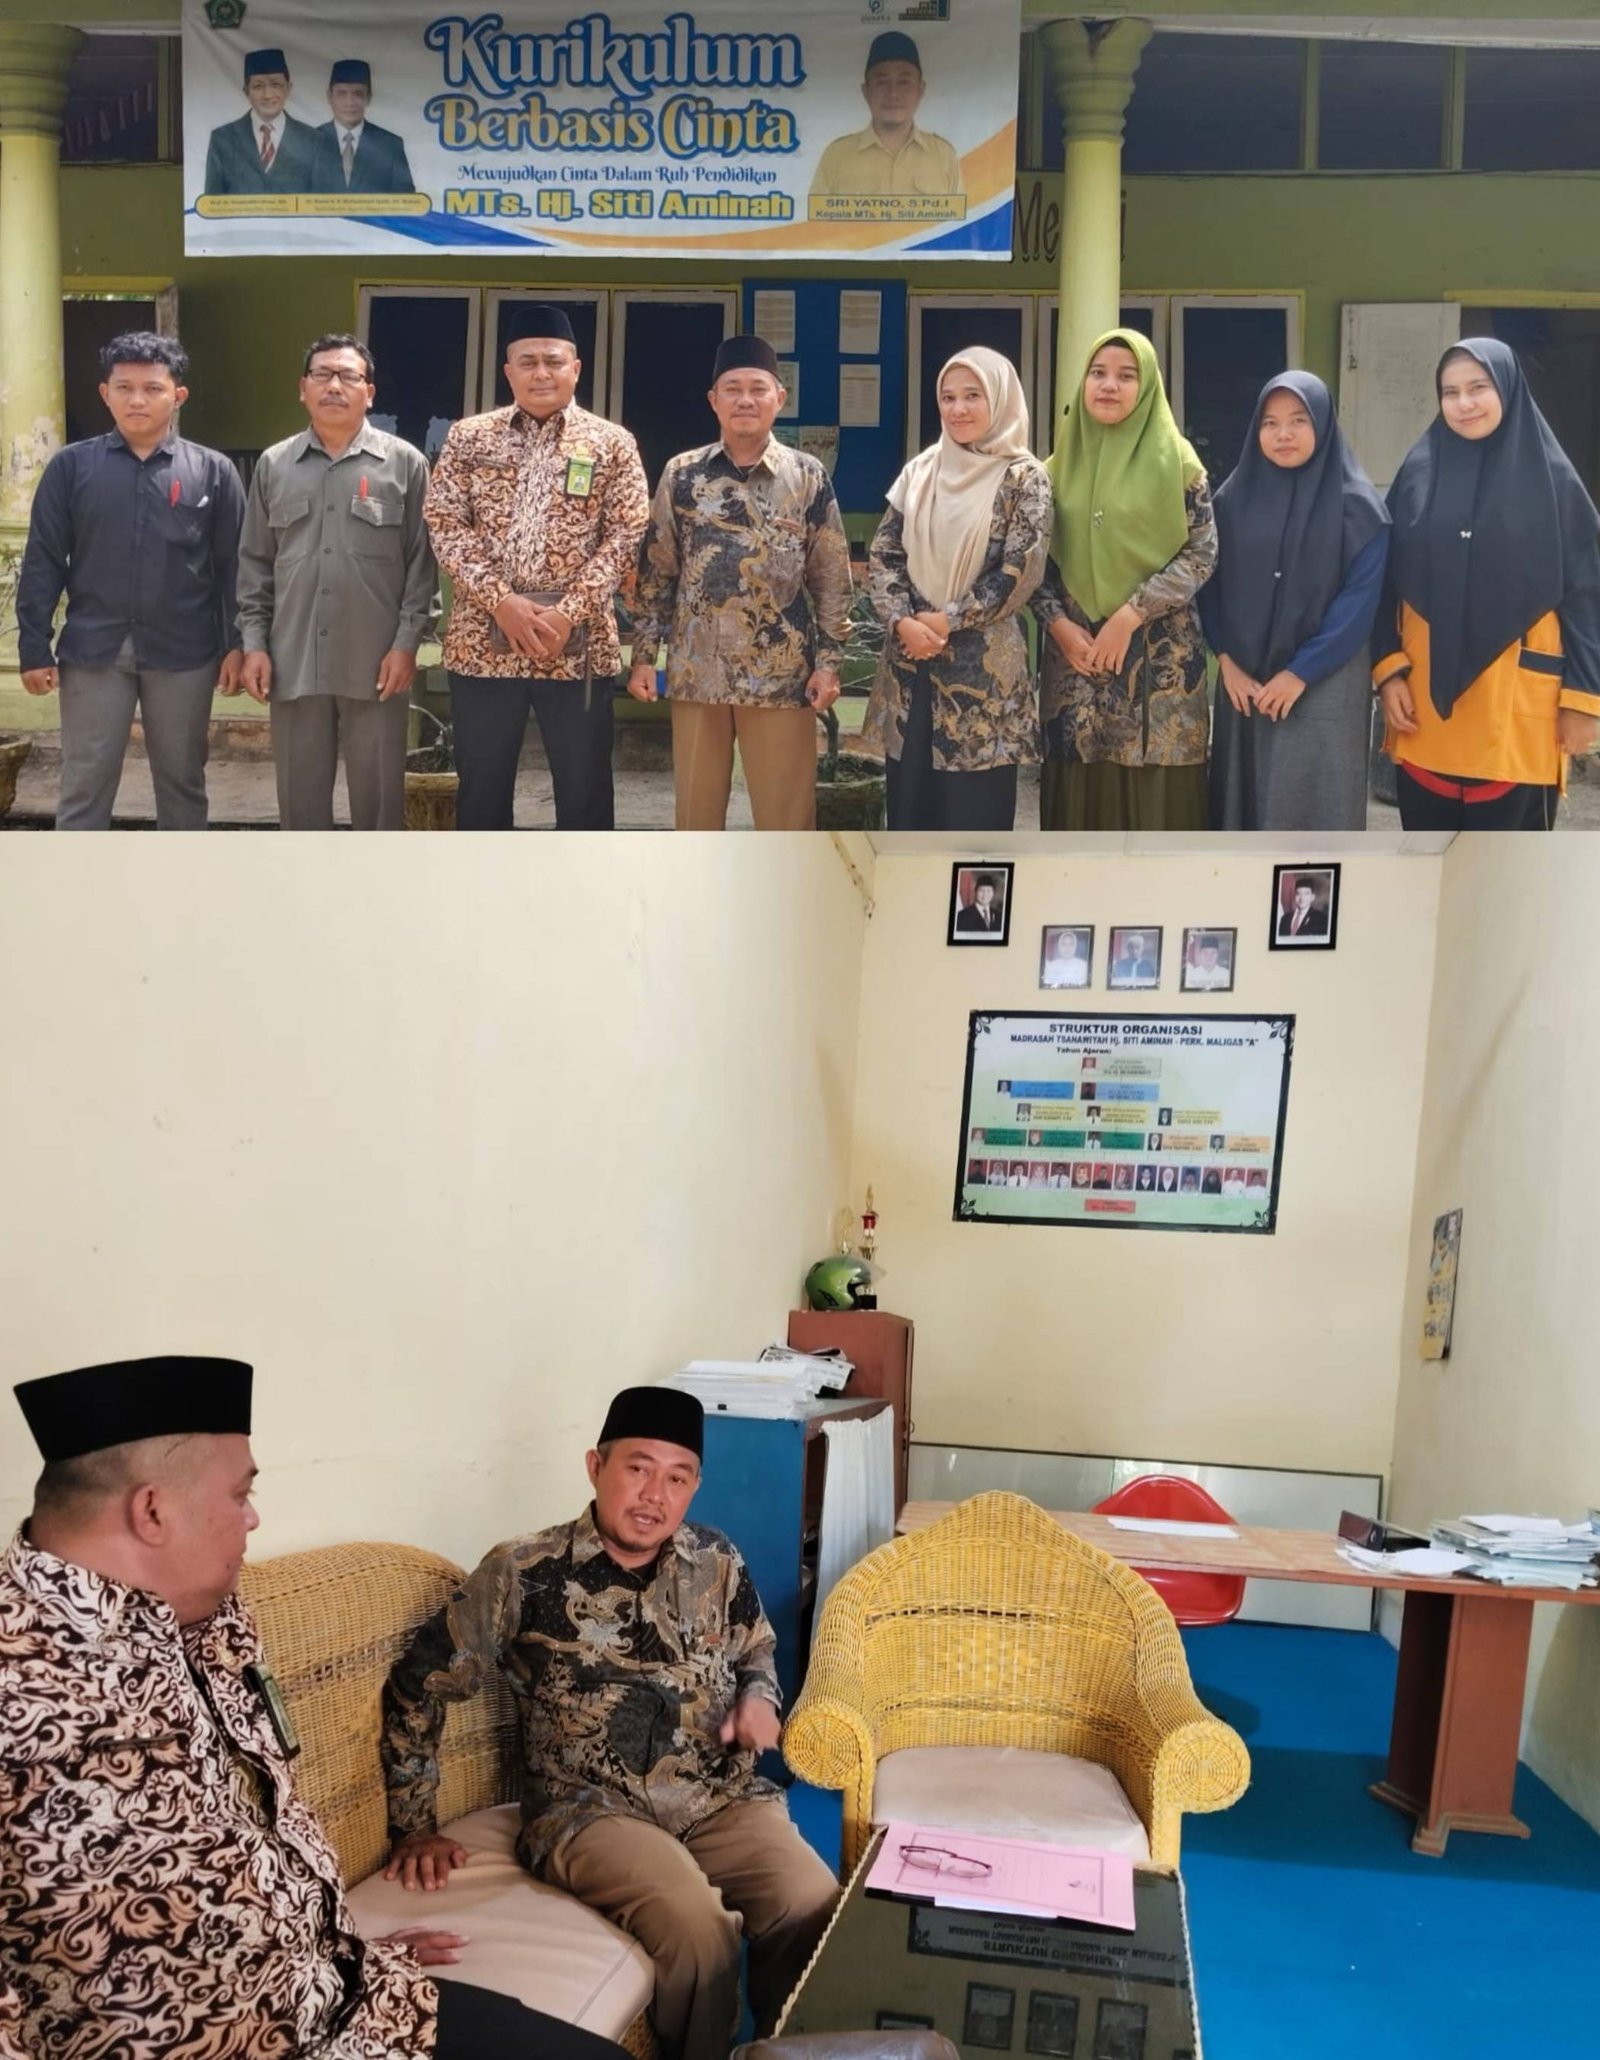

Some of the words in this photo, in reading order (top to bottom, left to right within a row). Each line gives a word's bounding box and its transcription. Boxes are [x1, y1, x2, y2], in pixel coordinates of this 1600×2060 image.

[424, 13, 806, 100] Kurikulum
[424, 92, 654, 152] Berbasis
[659, 94, 800, 160] Cinta
[458, 165, 557, 184] Mewujudkan
[561, 166, 598, 181] Cinta
[602, 166, 652, 182] Dalam
[655, 166, 689, 184] Ruh
[692, 166, 777, 185] Pendidikan
[444, 188, 531, 218] MTs.
[537, 189, 584, 221] Hj.
[590, 189, 653, 219] Siti
[659, 189, 794, 220] Aminah
[826, 199, 850, 209] SRI
[815, 210, 852, 220] Kepala
[897, 210, 914, 219] Siti
[917, 210, 957, 219] Aminah
[1049, 1023, 1119, 1034] STRUKTUR
[1122, 1025, 1203, 1035] ORGANISASI
[1010, 1034, 1055, 1043] MADRASAH
[1056, 1035, 1108, 1045] TSANAWIYAH
[1123, 1036, 1139, 1045] SITI
[1140, 1037, 1173, 1046] AMINAH
